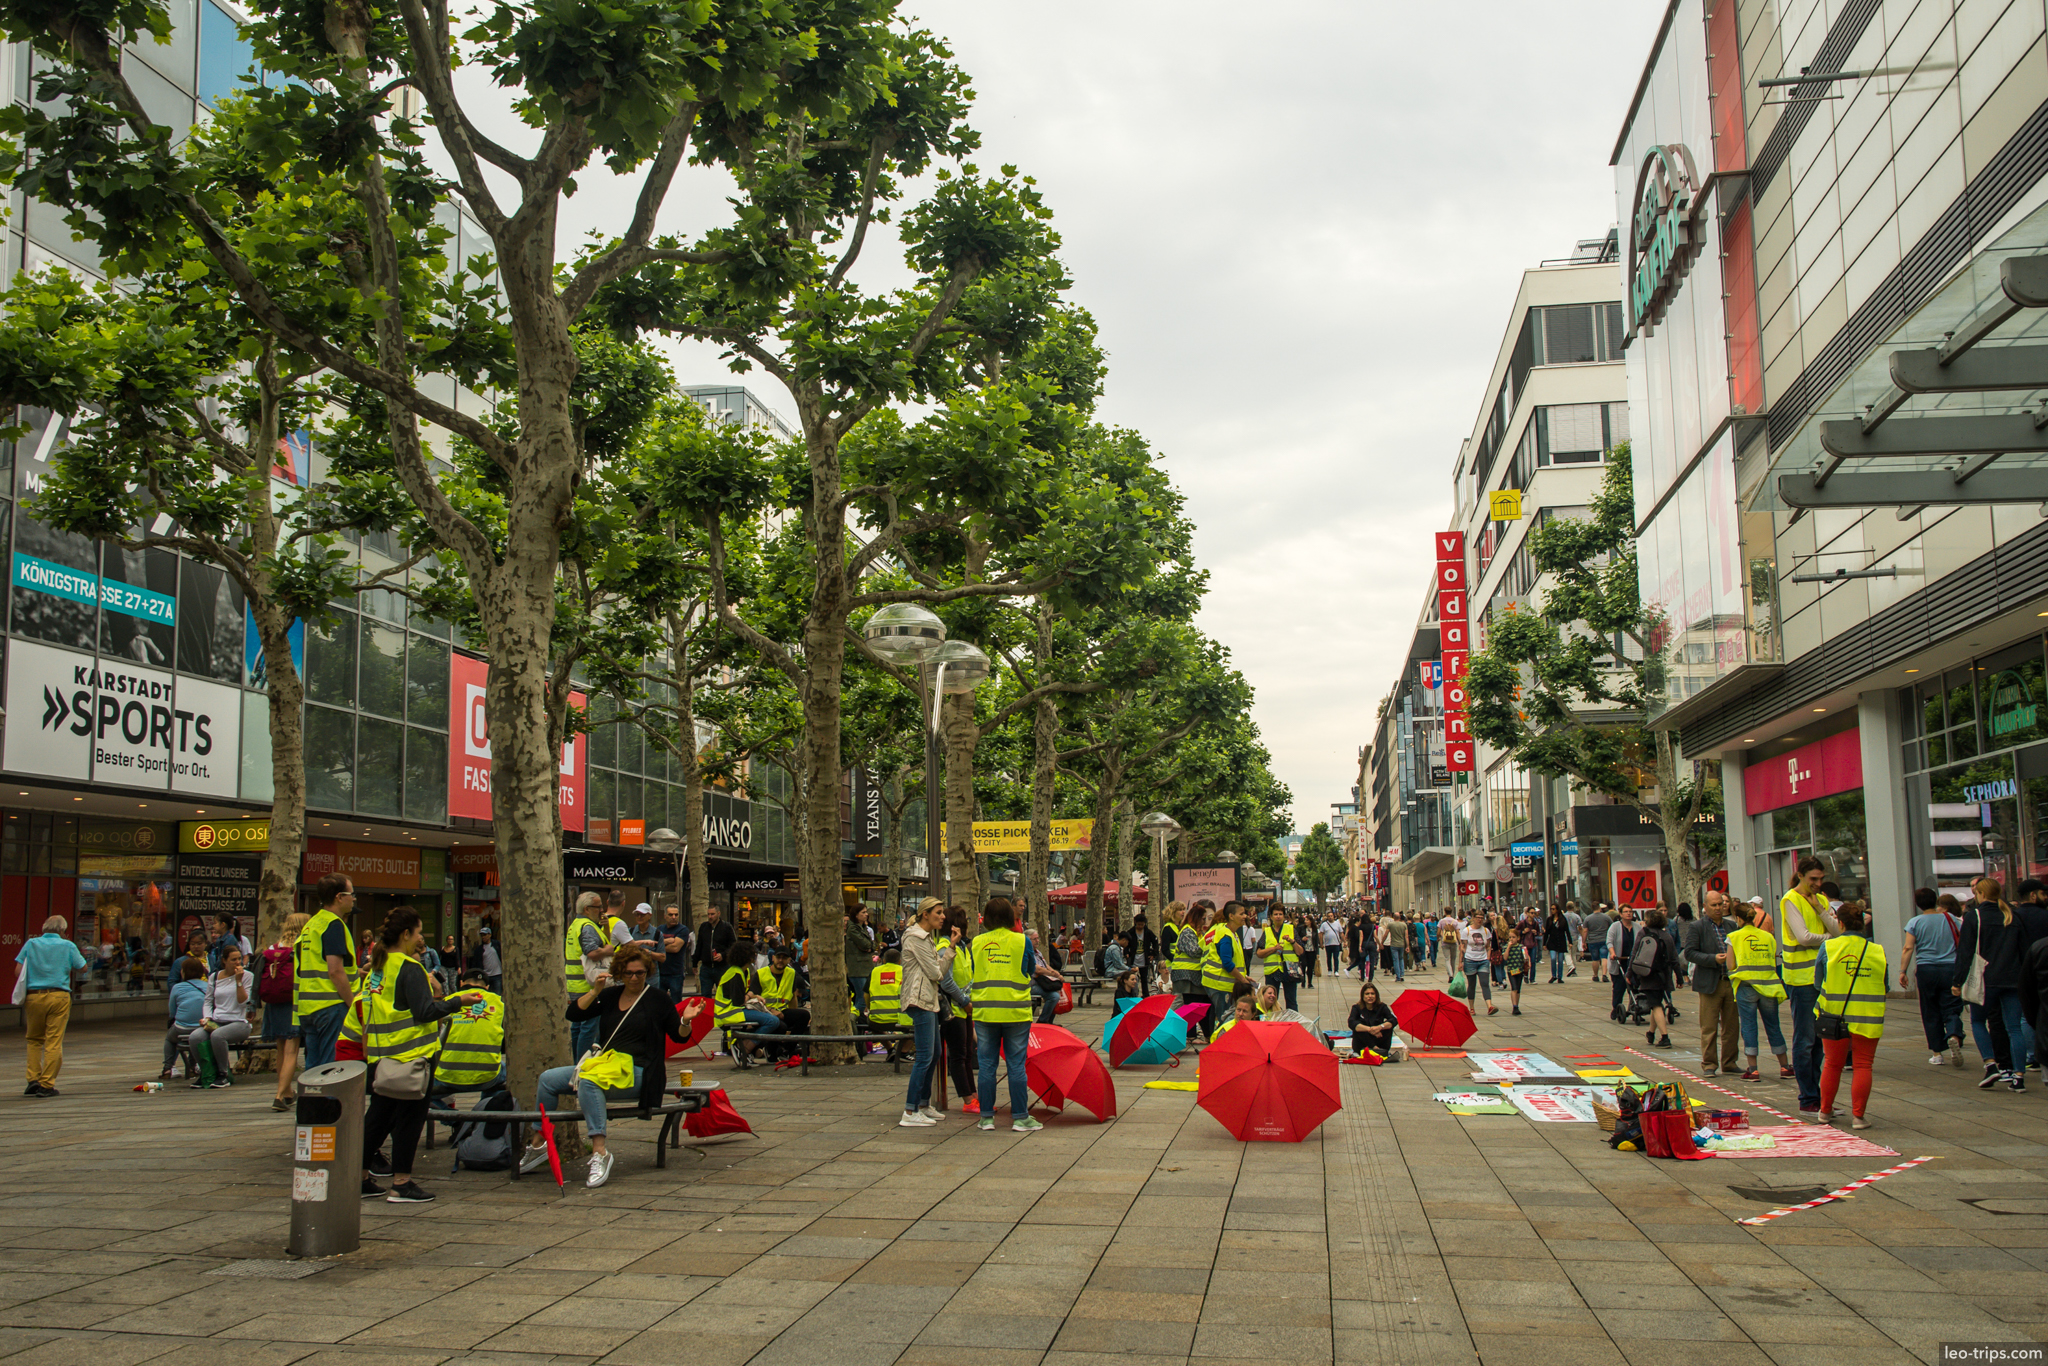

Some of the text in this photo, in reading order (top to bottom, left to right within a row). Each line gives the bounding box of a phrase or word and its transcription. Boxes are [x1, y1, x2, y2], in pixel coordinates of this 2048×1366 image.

[21, 561, 173, 619] KÖNIGSTRASSE 27+27A
[1442, 538, 1468, 764] vodafone
[74, 665, 172, 702] KARSTADT
[70, 690, 212, 756] SPORTS
[96, 748, 210, 778] Bester Sport vor Ort.
[1963, 778, 2017, 804] SEPHORA
[867, 789, 879, 841] YEANS
[218, 823, 268, 847] go asi
[972, 826, 1069, 838] OSSE PICKKEN
[339, 855, 383, 873] K-SPORTS
[385, 859, 418, 875] OUTLET
[453, 854, 497, 865] K-SPORT
[181, 865, 249, 878] ENTDECKE UNSERE
[573, 867, 626, 878] MANGO
[1190, 868, 1218, 878] benefit
[180, 885, 256, 898] NEUE FILIALE IN DER
[735, 880, 777, 889] MANGO
[180, 896, 246, 911] KÖNIGSTRASSE 27.
[2, 934, 21, 945] 30%
